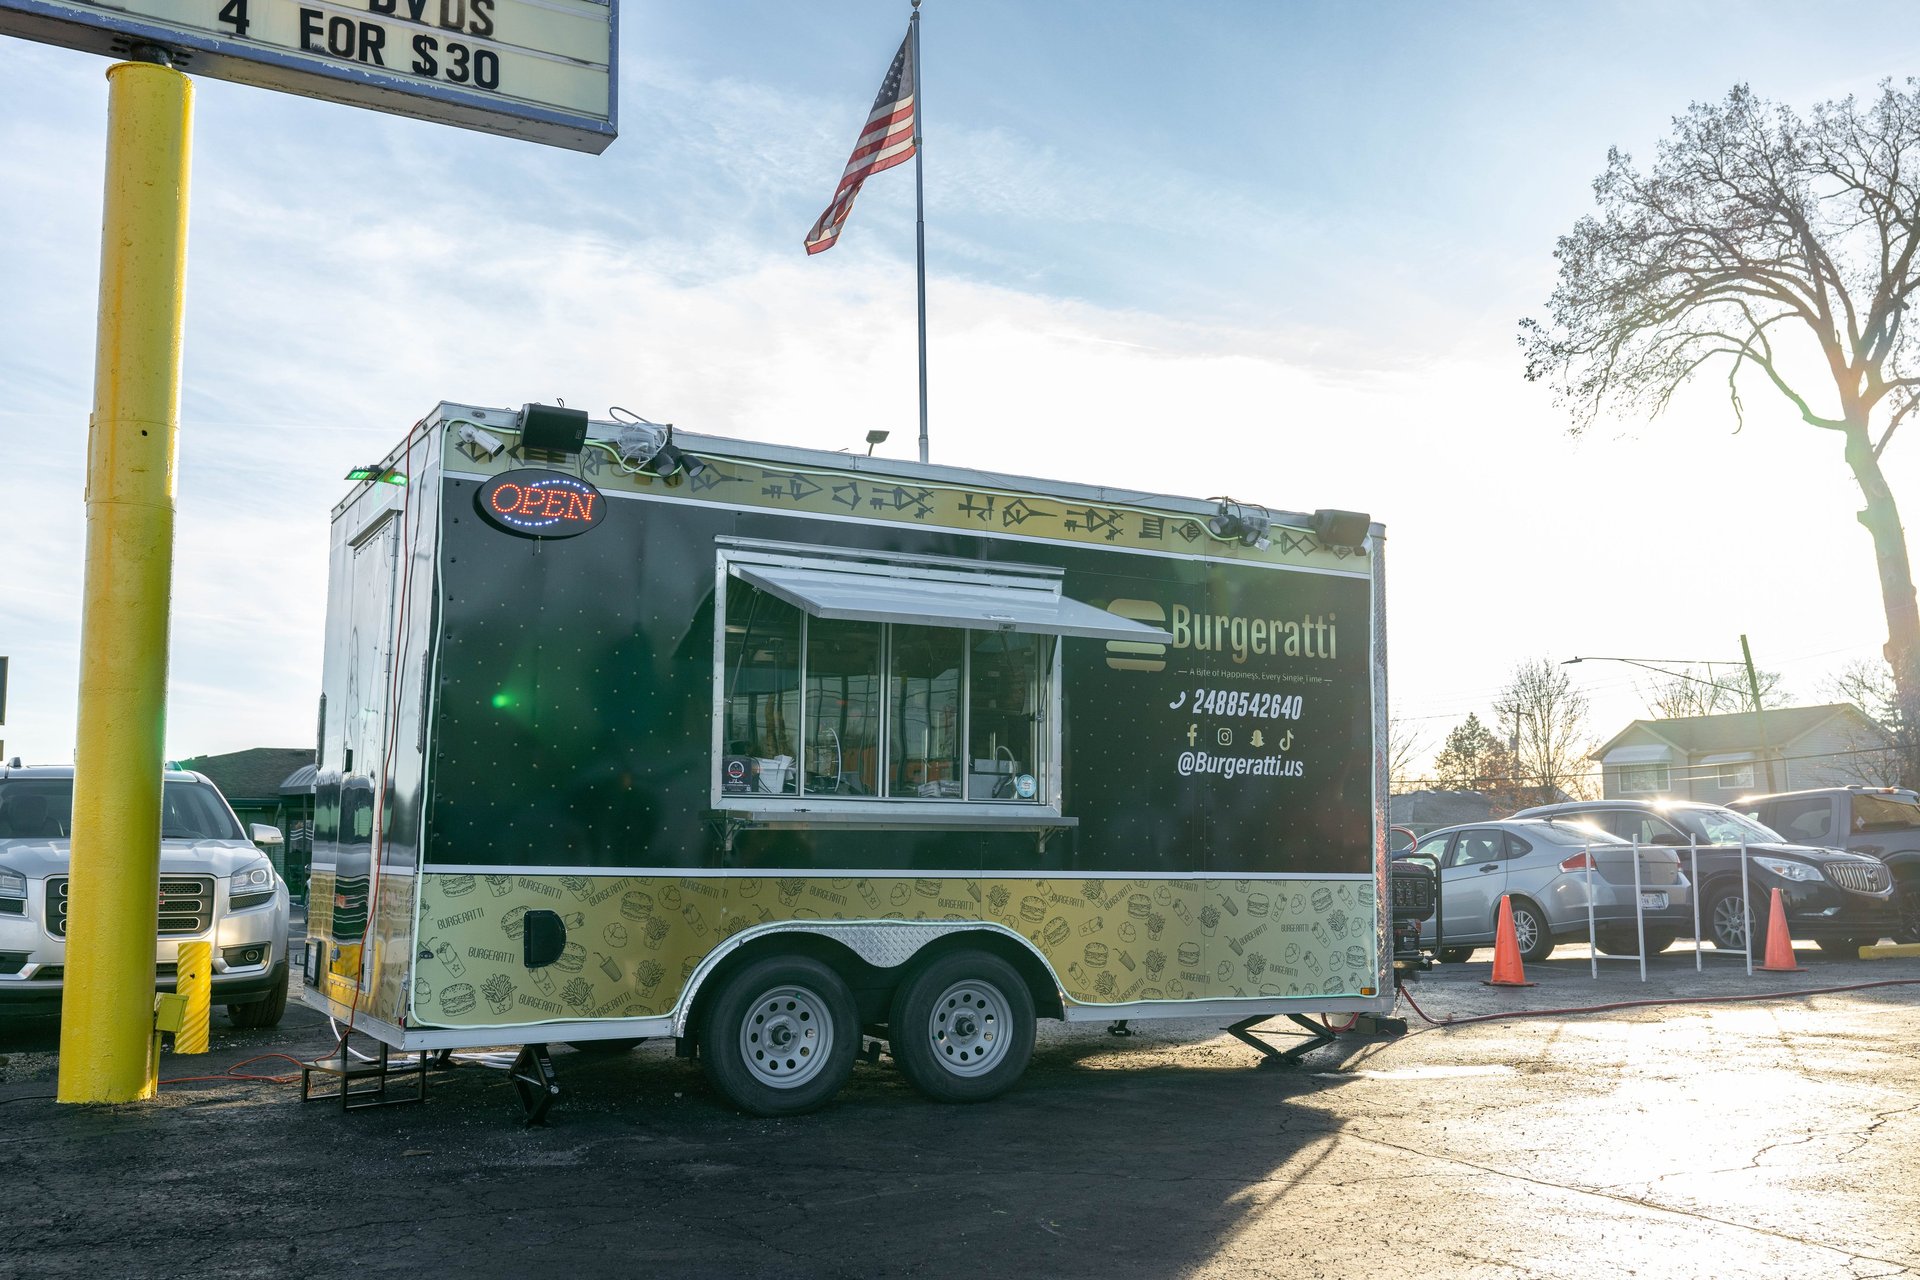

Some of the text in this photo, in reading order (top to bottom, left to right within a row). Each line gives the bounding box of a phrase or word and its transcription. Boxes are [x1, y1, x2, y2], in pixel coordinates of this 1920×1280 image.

[218, 0, 500, 90] 4 FOR $30
[492, 483, 596, 521] OPEN
[1172, 603, 1337, 664] Burgeratti
[1196, 668, 1211, 677] Bite
[1262, 672, 1281, 683] Every
[1282, 674, 1304, 684] Single
[1304, 675, 1323, 684] Time
[1192, 689, 1303, 720] 2488542640
[1177, 751, 1304, 779] @Burgeratti.us
[517, 876, 563, 900] BURGERATTI
[588, 878, 631, 907] BURGERATTI
[809, 885, 848, 907] BURGERATTI
[1104, 883, 1133, 911] BURGERATTI
[938, 897, 974, 911] BURGERATTI
[437, 907, 485, 930] BURGERATTI
[1280, 923, 1309, 933] BURGERATTI
[1238, 923, 1268, 946] BURGERATTI
[468, 946, 515, 965] BURGERATTI
[1180, 970, 1211, 985] BURGERATTI
[1269, 964, 1299, 978] BURGERATTI
[518, 992, 563, 1015] BURGERATTI
